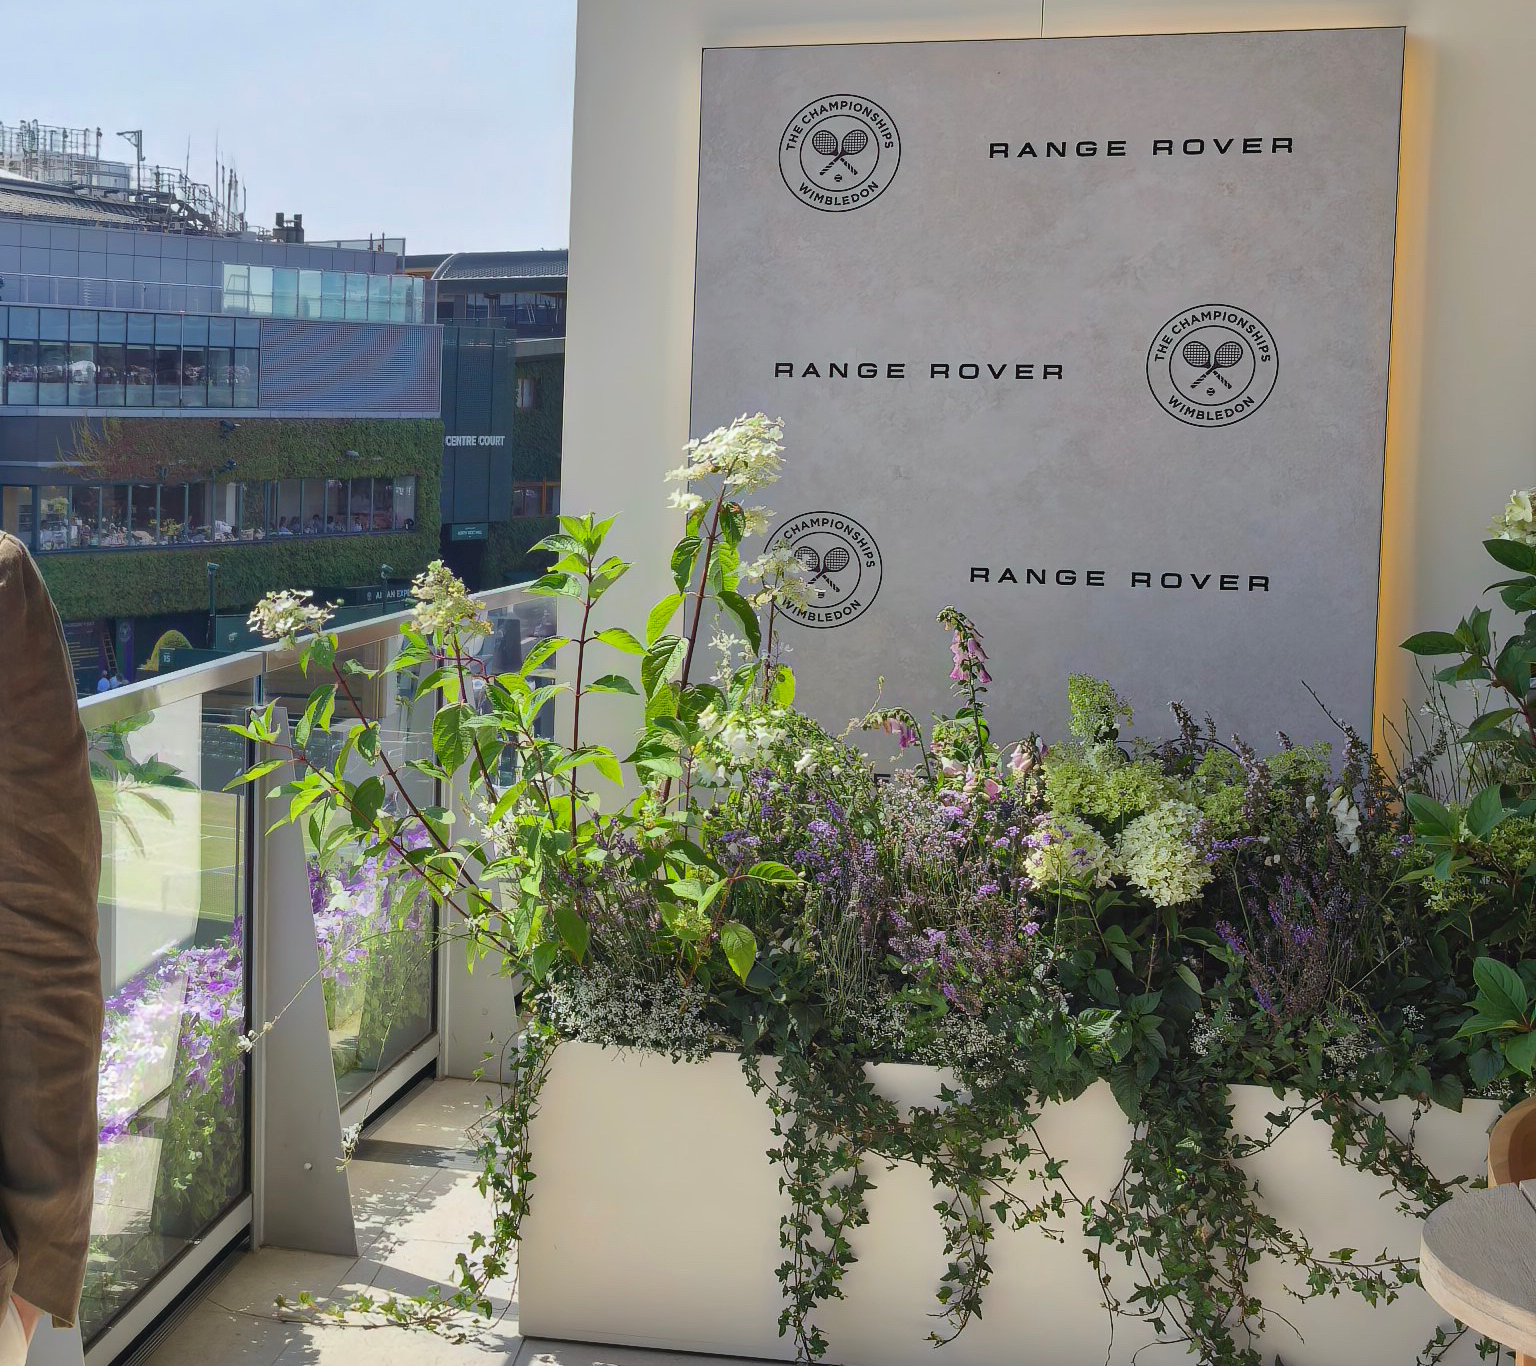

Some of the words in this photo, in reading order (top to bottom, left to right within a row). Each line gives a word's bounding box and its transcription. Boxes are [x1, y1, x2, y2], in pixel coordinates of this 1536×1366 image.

[785, 124, 804, 151] THE
[801, 100, 894, 149] CHAMPIONSHIPS
[989, 140, 1127, 159] RANGE
[1152, 137, 1293, 156] ROVER
[798, 180, 880, 206] WIMBLEDON
[1154, 334, 1174, 362] THE
[1171, 310, 1271, 363] CHAMPIONSHIPS
[774, 362, 906, 379] RANGE
[930, 363, 1063, 380] ROVER
[1168, 394, 1255, 421] WIMBLEDON
[445, 435, 477, 447] CENTRE
[478, 435, 505, 446] COURT
[783, 517, 876, 569] CHAMPIONSHIPS
[969, 566, 1106, 587] RANGE
[1130, 571, 1270, 592] ROVER
[781, 598, 863, 623] WIMBLEDON
[163, 654, 171, 663] 15
